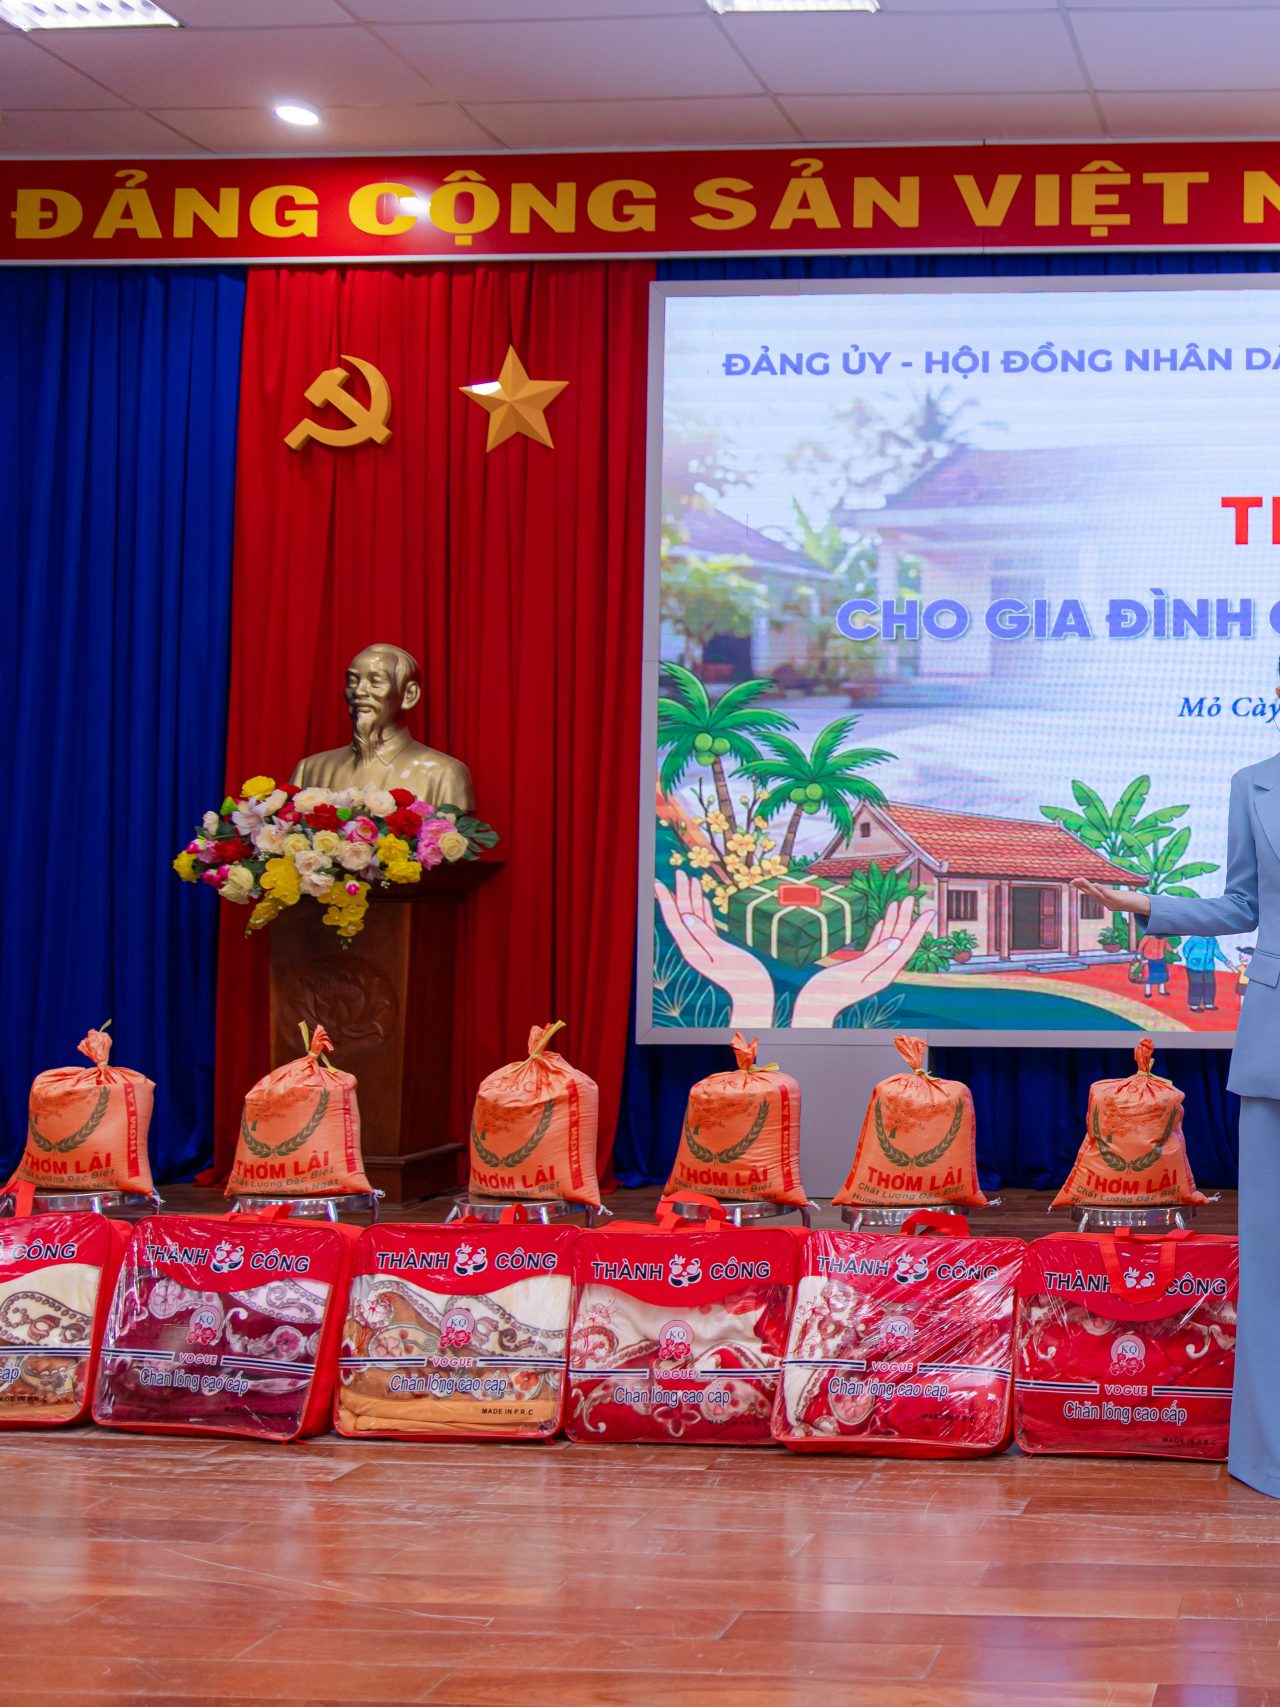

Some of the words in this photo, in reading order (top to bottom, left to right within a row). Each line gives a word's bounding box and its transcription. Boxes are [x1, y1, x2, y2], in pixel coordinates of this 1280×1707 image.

[11, 169, 319, 240] ĐẢNG
[348, 169, 658, 247] CỘNG
[690, 157, 921, 233] SẢN
[954, 160, 1209, 237] VIỆT
[722, 345, 830, 376] ĐẢNG
[842, 343, 892, 376] ỦY
[924, 345, 990, 380] HỘI
[1000, 341, 1113, 374] ĐỒNG
[1124, 342, 1233, 372] NHÂN
[836, 596, 970, 642] CHO
[985, 597, 1092, 642] GIA
[1106, 587, 1253, 642] ĐÌNH
[1178, 696, 1222, 717] Mỏ
[12, 1238, 77, 1260] CÔNG
[145, 1242, 210, 1265] THÀNH
[250, 1248, 311, 1273] CÔNG
[377, 1248, 449, 1270] THÀNH
[495, 1247, 558, 1270] CÔNG
[592, 1258, 663, 1281] THÀNH
[709, 1256, 771, 1280] CÔNG
[818, 1255, 890, 1276] THÀNH
[937, 1260, 999, 1281] CÔNG
[199, 1315, 214, 1326] KQ
[450, 1319, 466, 1328] KQ
[891, 1324, 907, 1334] KQ
[669, 1331, 686, 1340] KQ
[179, 1352, 219, 1365] VOGUE
[1121, 1345, 1138, 1355] KQ
[431, 1357, 473, 1368] VOGUE
[871, 1361, 913, 1372] VOGUE
[140, 1367, 172, 1387] Chăn
[173, 1369, 200, 1392] lông
[201, 1375, 224, 1390] cao
[226, 1371, 249, 1396] cấp
[390, 1373, 425, 1392] Chăn
[427, 1373, 456, 1395] lông
[457, 1378, 481, 1392] cao
[483, 1370, 507, 1396] cấp
[653, 1369, 695, 1379] VOGUE
[614, 1387, 649, 1405] Chăn
[651, 1387, 679, 1408] lông
[681, 1391, 704, 1405] cao
[707, 1383, 730, 1407] cấp
[829, 1377, 864, 1396] Chăn
[866, 1378, 896, 1400] lông
[897, 1383, 922, 1397] cao
[924, 1377, 948, 1401] cấp
[1104, 1384, 1148, 1396] VOGUE
[1064, 1400, 1100, 1420] Chăn
[1102, 1401, 1131, 1425] lông
[1133, 1406, 1159, 1422] cao
[1161, 1400, 1187, 1426] cấp
